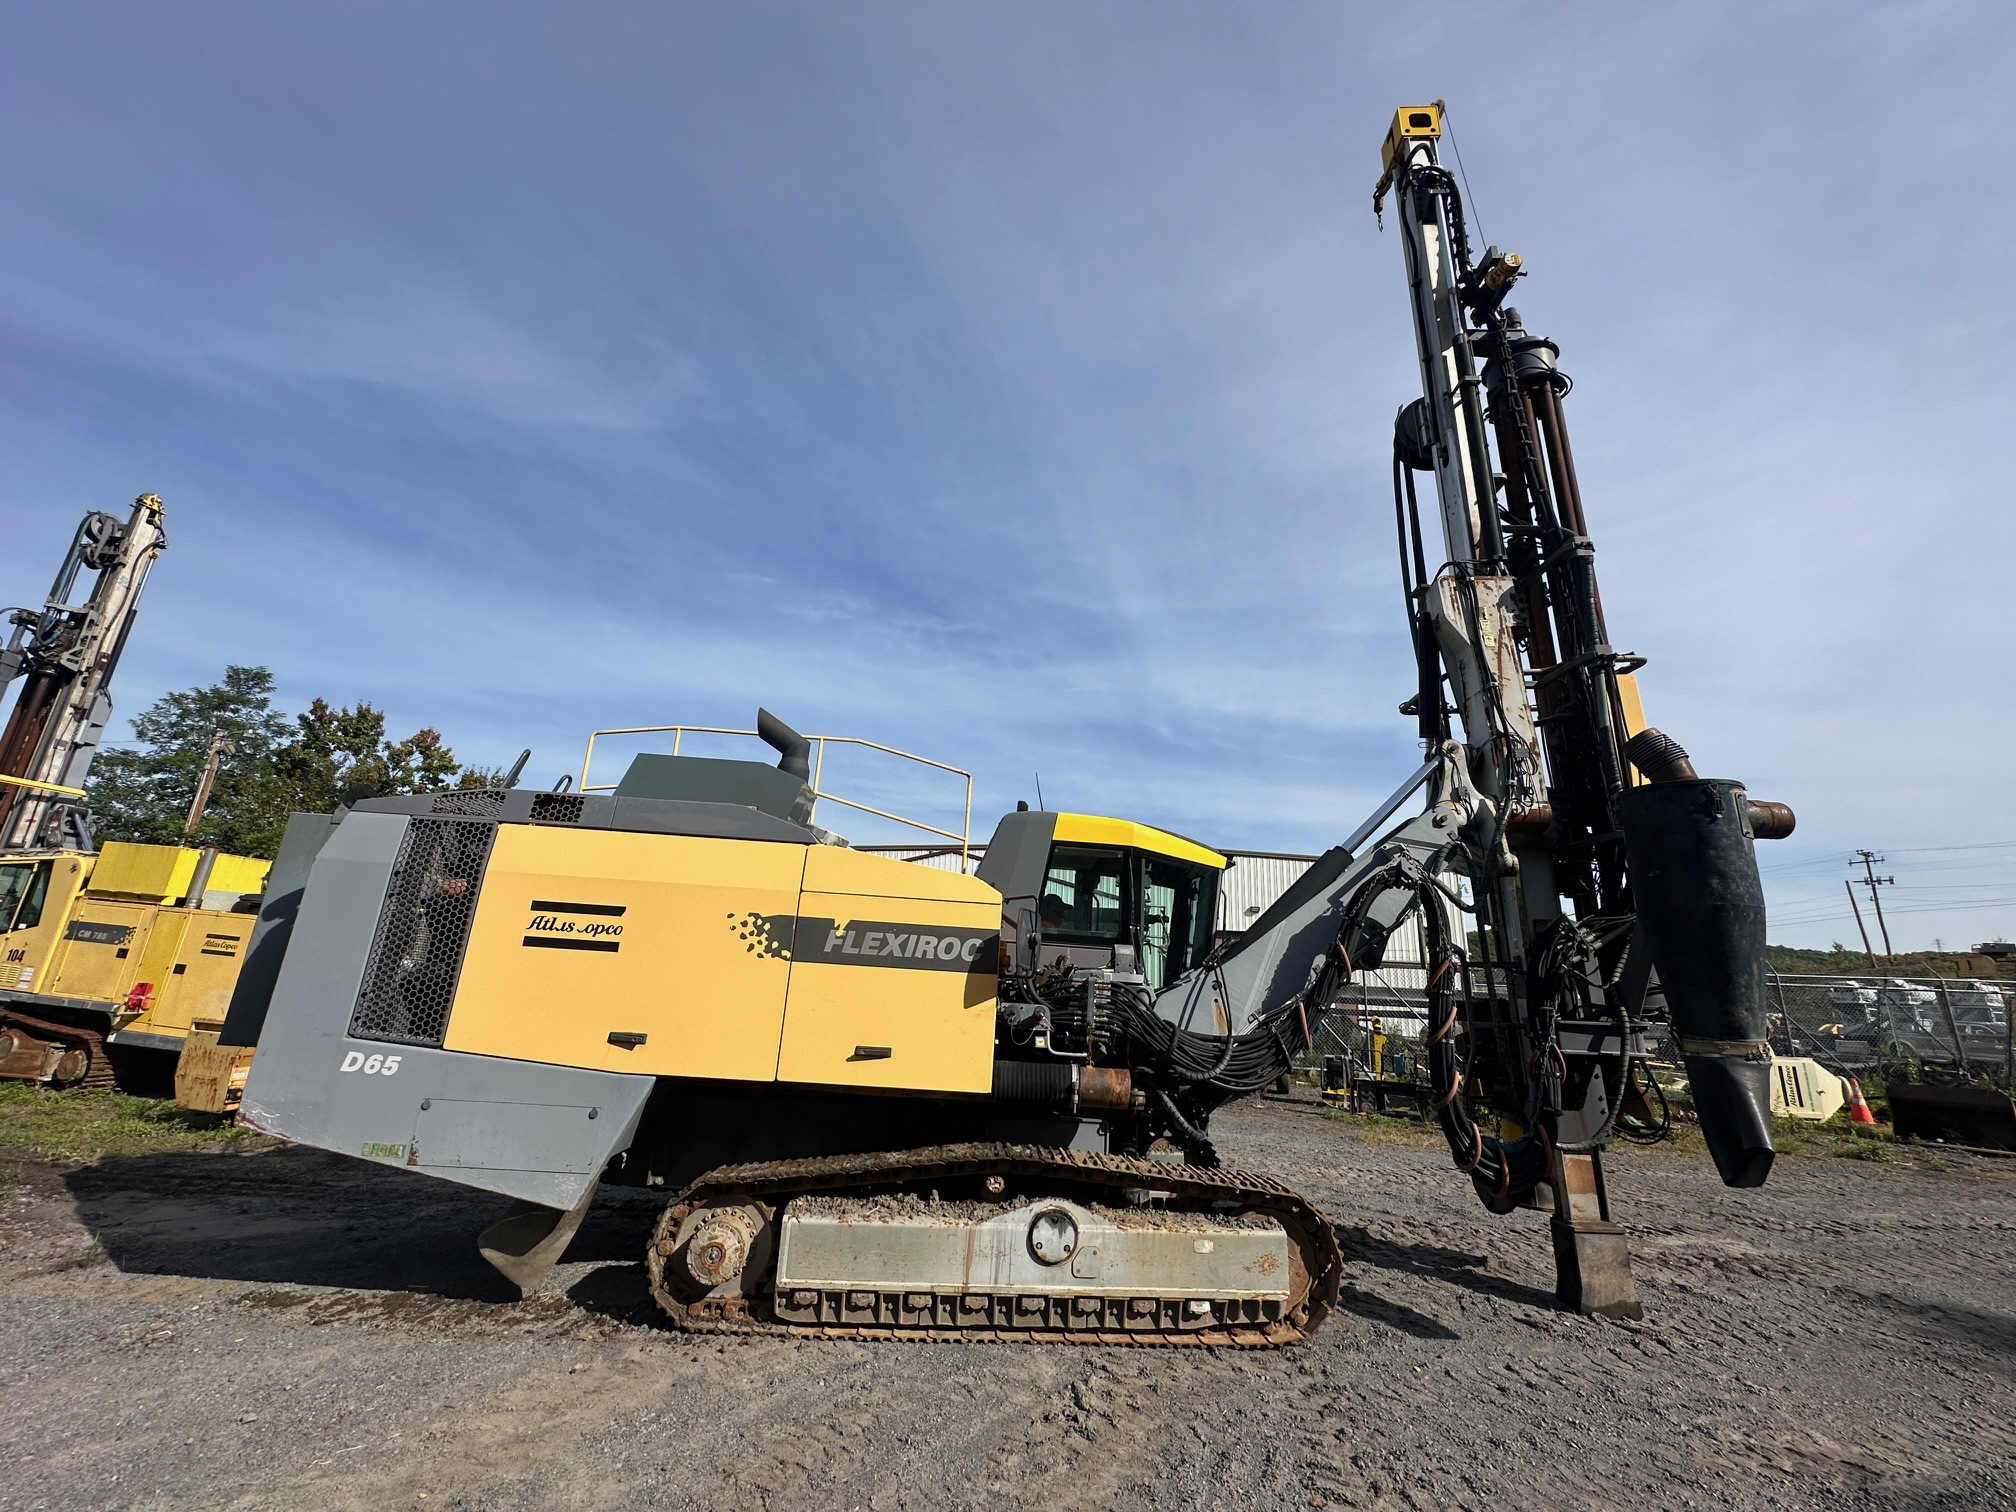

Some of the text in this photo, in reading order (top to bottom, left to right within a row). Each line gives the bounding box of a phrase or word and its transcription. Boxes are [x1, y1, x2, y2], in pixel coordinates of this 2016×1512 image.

[78, 929, 91, 938] CM
[203, 940, 238, 950] Atlas Copco
[823, 928, 985, 962] FLEXIROC
[6, 949, 26, 963] 104
[339, 1051, 402, 1076] D65
[1785, 1065, 1798, 1108] Atlas Copco
